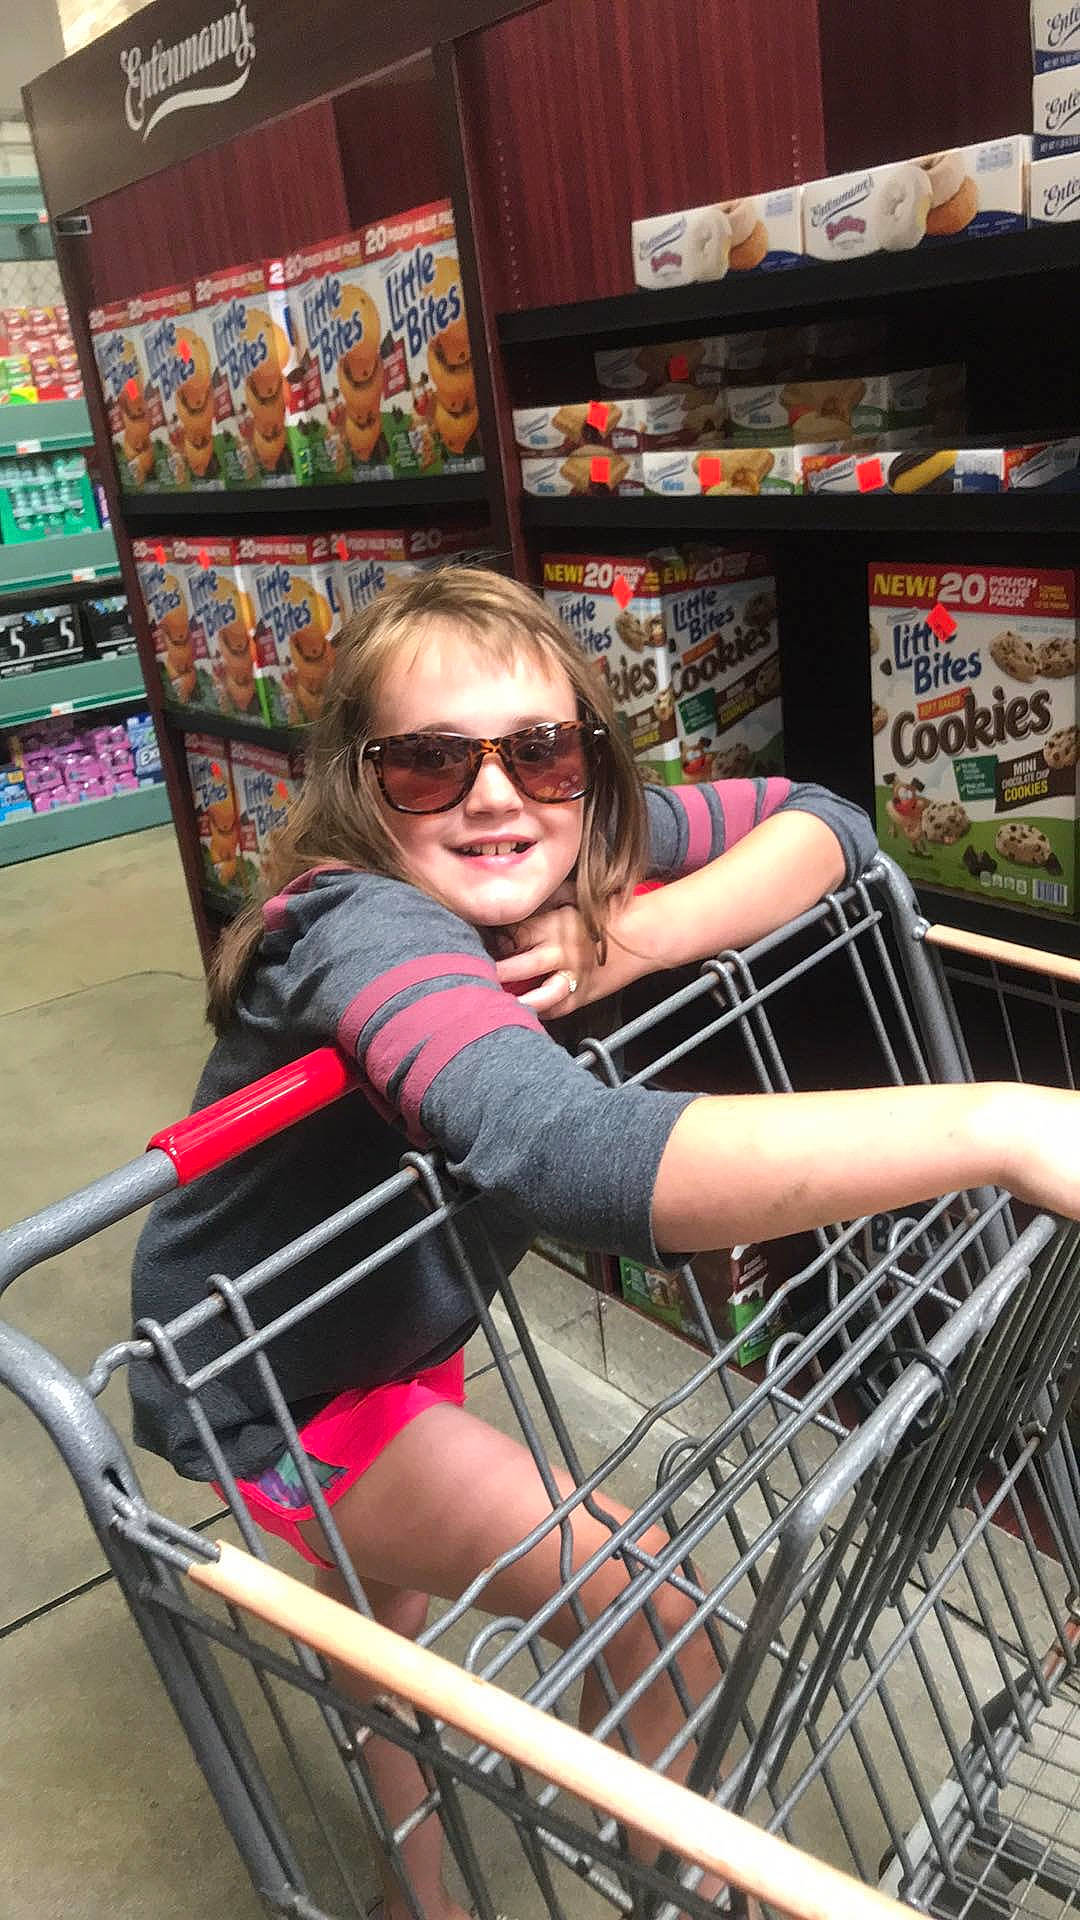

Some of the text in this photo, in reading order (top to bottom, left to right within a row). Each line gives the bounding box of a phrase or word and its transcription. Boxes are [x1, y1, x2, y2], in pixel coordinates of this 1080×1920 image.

[120, 0, 256, 131] Entenmann's
[365, 226, 385, 255] 20
[285, 254, 304, 280] 20
[196, 280, 213, 302] 20
[384, 247, 435, 332] Little
[303, 276, 342, 350] Little
[406, 284, 461, 358] Bites
[212, 300, 248, 368] Little
[318, 311, 363, 374] Bites
[226, 334, 268, 389] Bites
[239, 539, 256, 558] 20
[410, 530, 443, 553] 20
[255, 565, 291, 621] Little
[544, 564, 584, 583] NEW!
[584, 563, 613, 588] 20
[873, 572, 986, 604] NEW! 20
[988, 575, 1037, 588] POUCH
[989, 586, 1031, 599] VALUE
[203, 598, 236, 637] Bites
[271, 600, 311, 643] Bites
[672, 589, 718, 632] Little
[989, 597, 1025, 608] PACK
[10, 625, 27, 659] 5
[60, 616, 76, 649] 5
[689, 605, 735, 645] Bites
[914, 650, 983, 695] Bites
[891, 686, 1053, 767] Cookies
[1013, 758, 1037, 776] MINI
[242, 773, 275, 814] Little
[1004, 780, 1049, 803] COOKIES
